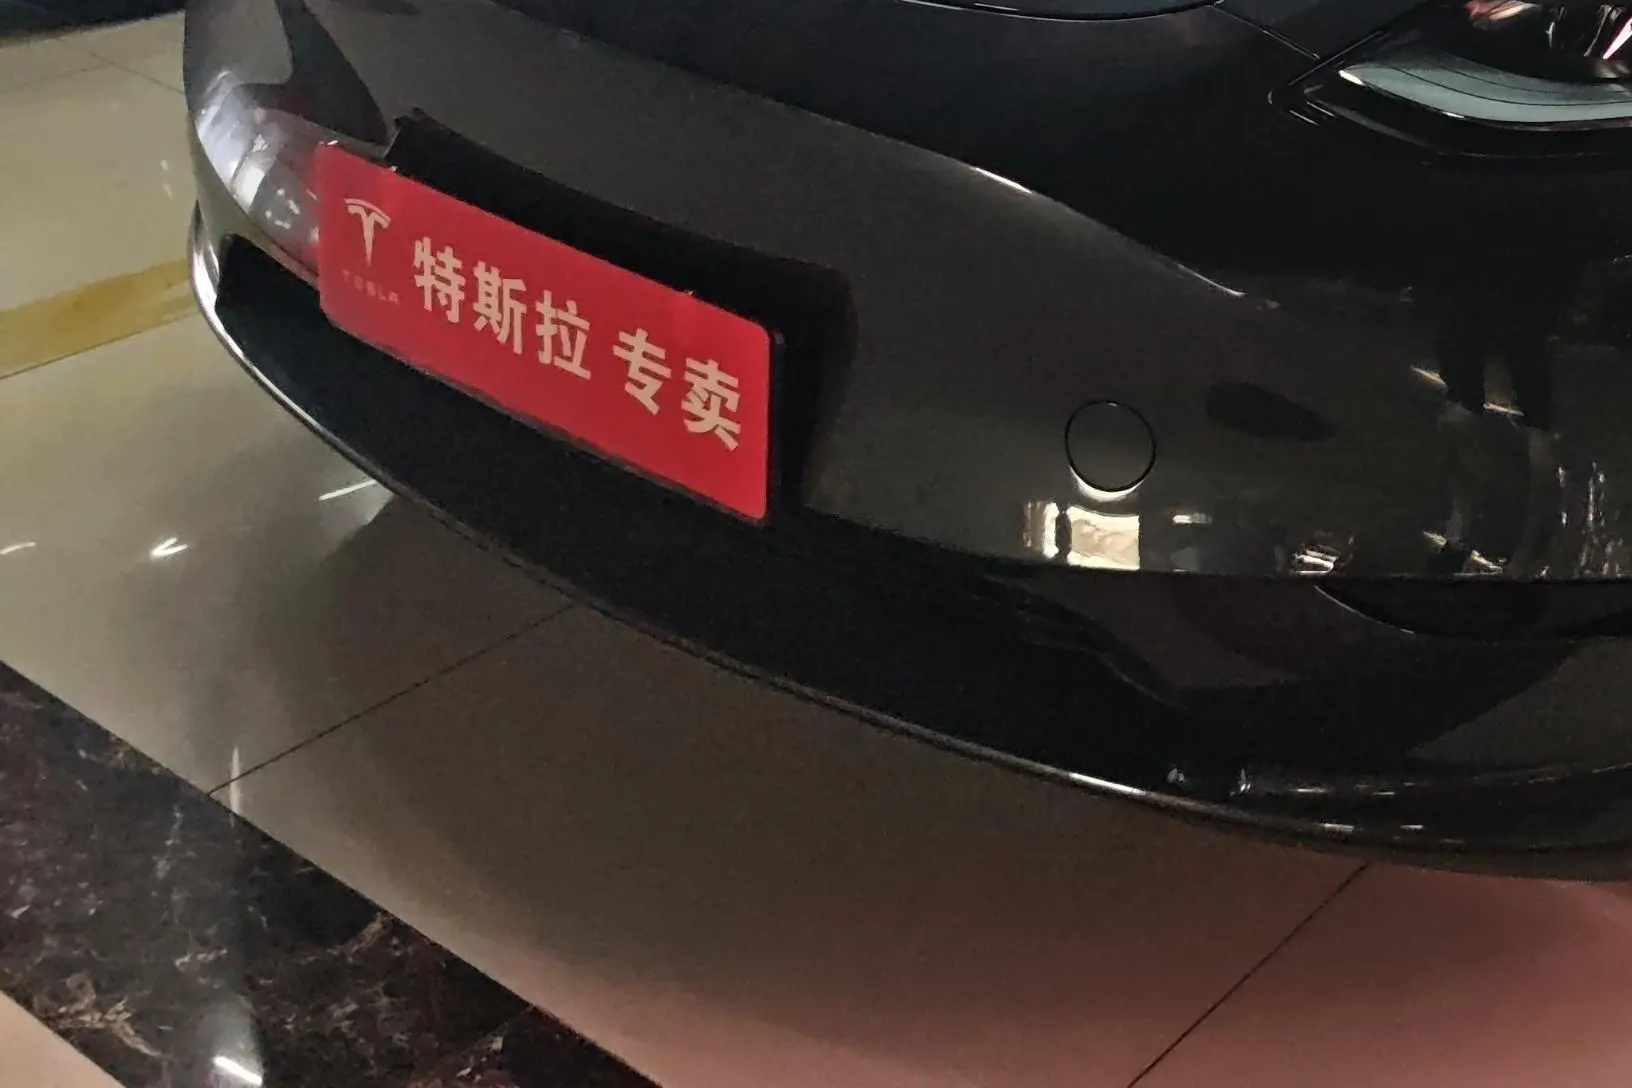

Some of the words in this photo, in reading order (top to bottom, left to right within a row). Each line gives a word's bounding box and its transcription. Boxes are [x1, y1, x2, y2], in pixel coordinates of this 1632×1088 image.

[413, 237, 592, 381] 特斯拉
[612, 328, 742, 453] 专卖
